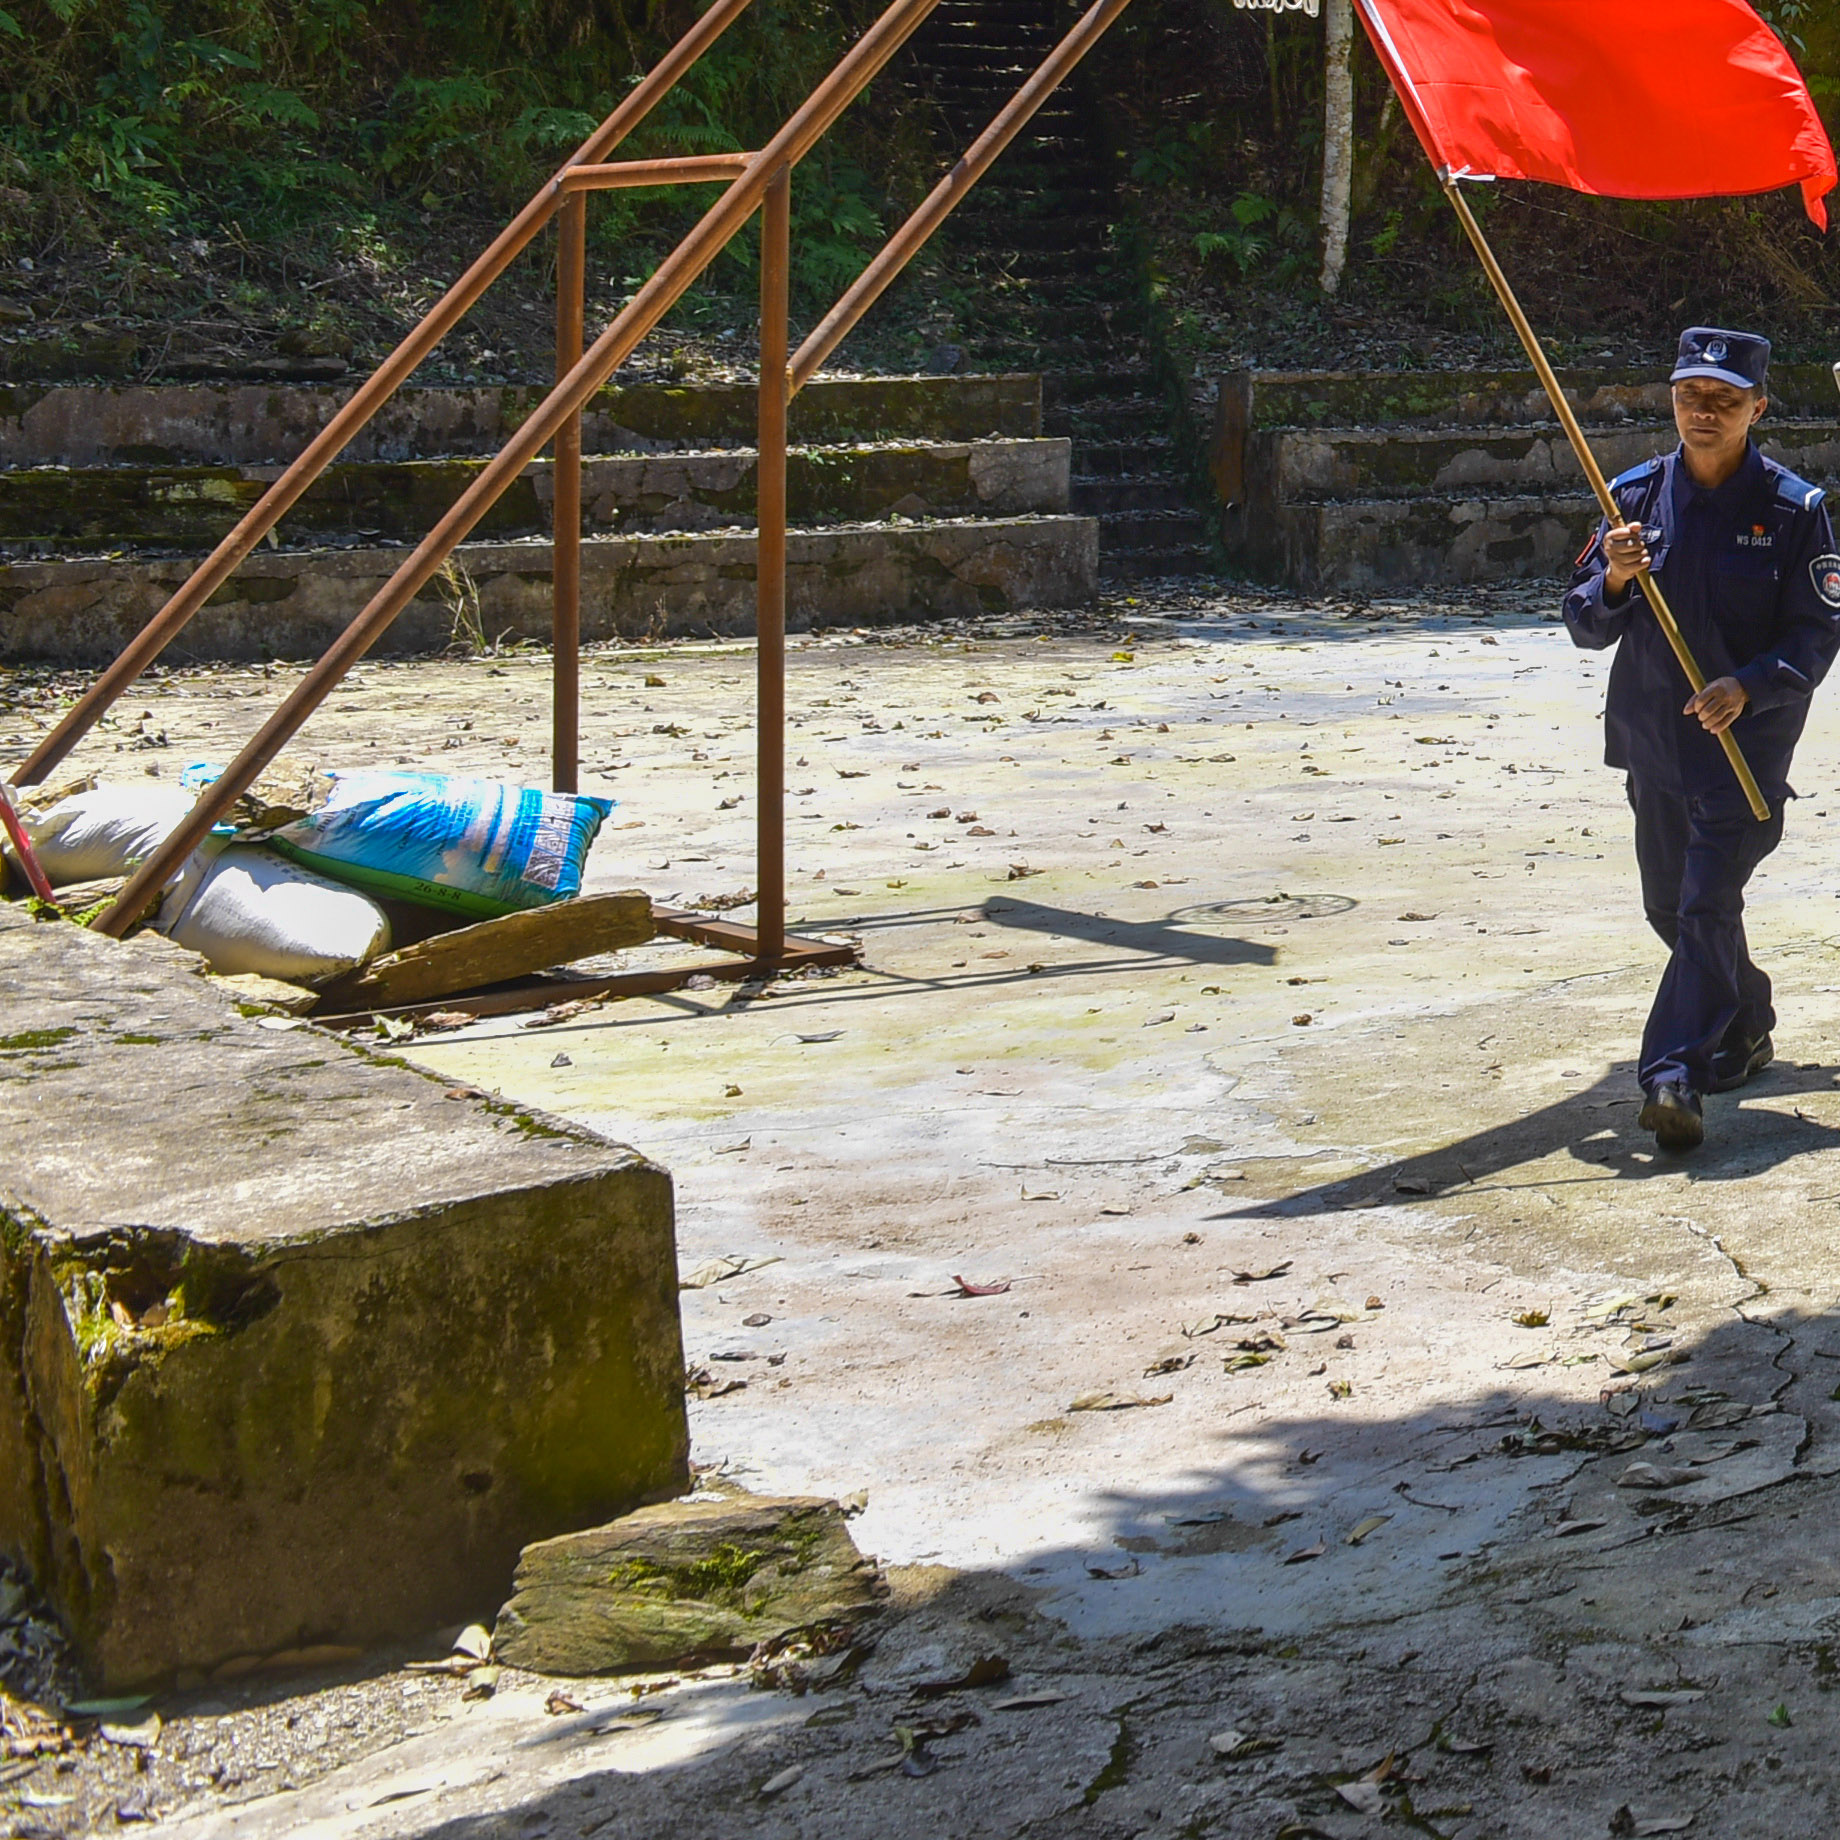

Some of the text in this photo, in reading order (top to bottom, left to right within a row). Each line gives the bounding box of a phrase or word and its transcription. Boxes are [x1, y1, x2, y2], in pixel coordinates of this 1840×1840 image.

[1736, 535, 1773, 547] WS 0412
[414, 881, 462, 901] 26-8-8
